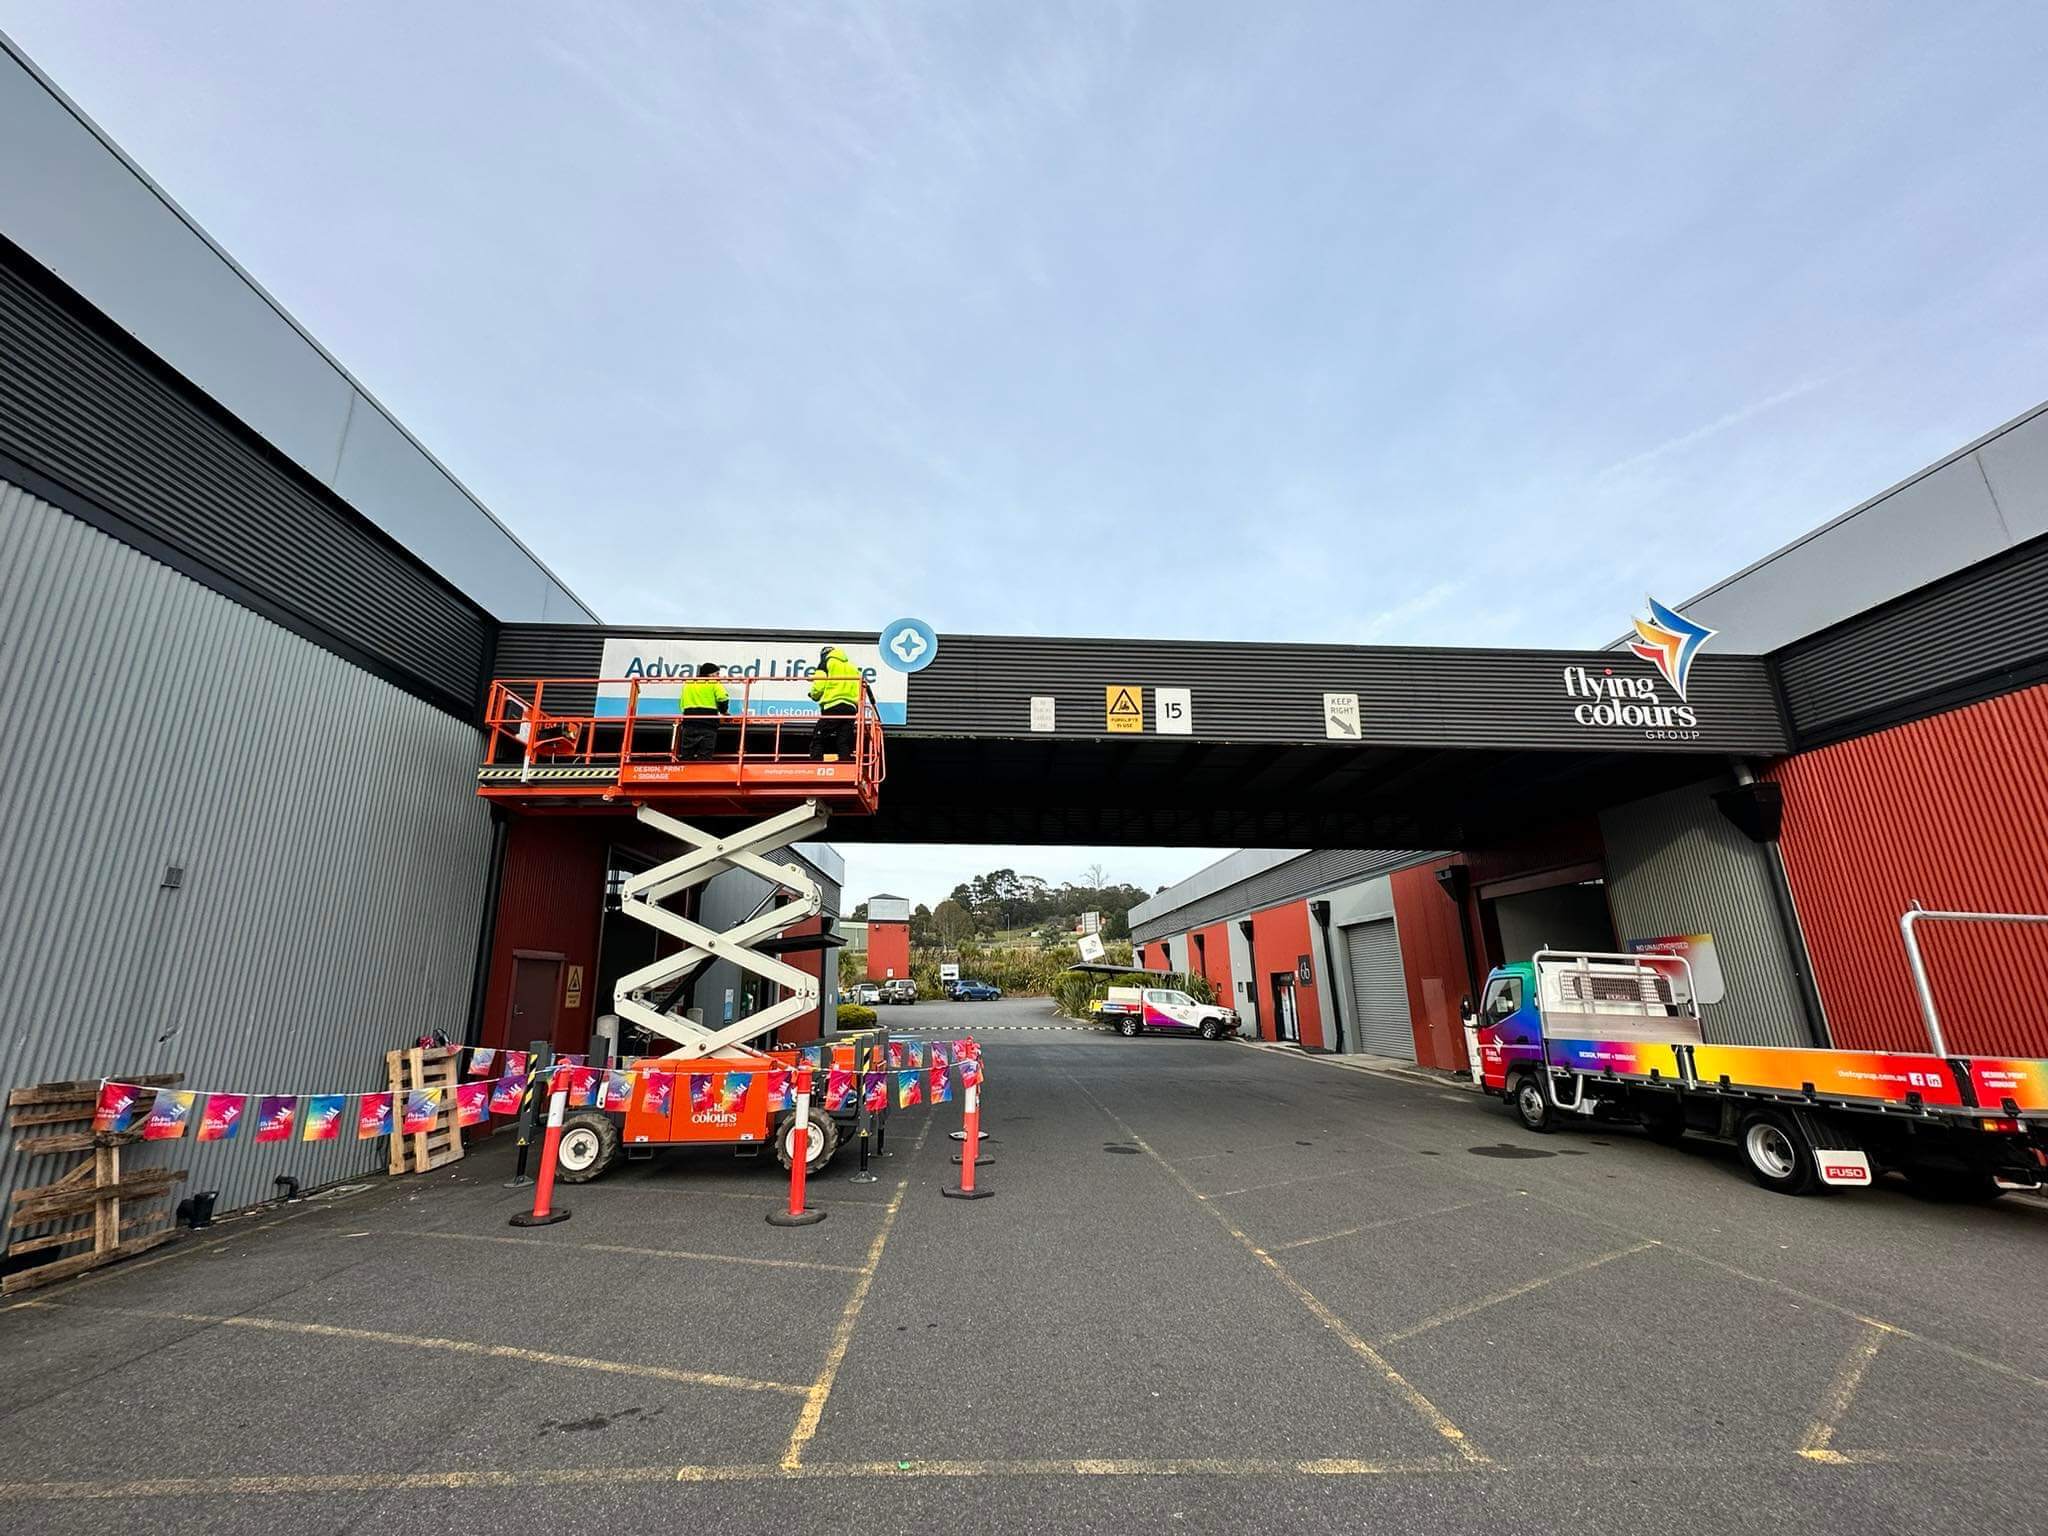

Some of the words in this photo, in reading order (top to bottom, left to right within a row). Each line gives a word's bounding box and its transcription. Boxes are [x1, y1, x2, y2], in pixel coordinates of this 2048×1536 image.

[624, 656, 761, 678] Advaed
[1564, 666, 1660, 704] flying
[767, 706, 820, 715] Custom
[1165, 703, 1182, 719] 15
[1574, 699, 1697, 728] colours
[1645, 730, 1700, 740] GROUP
[692, 1108, 737, 1123] colours
[1830, 1167, 1864, 1177] FUSO
